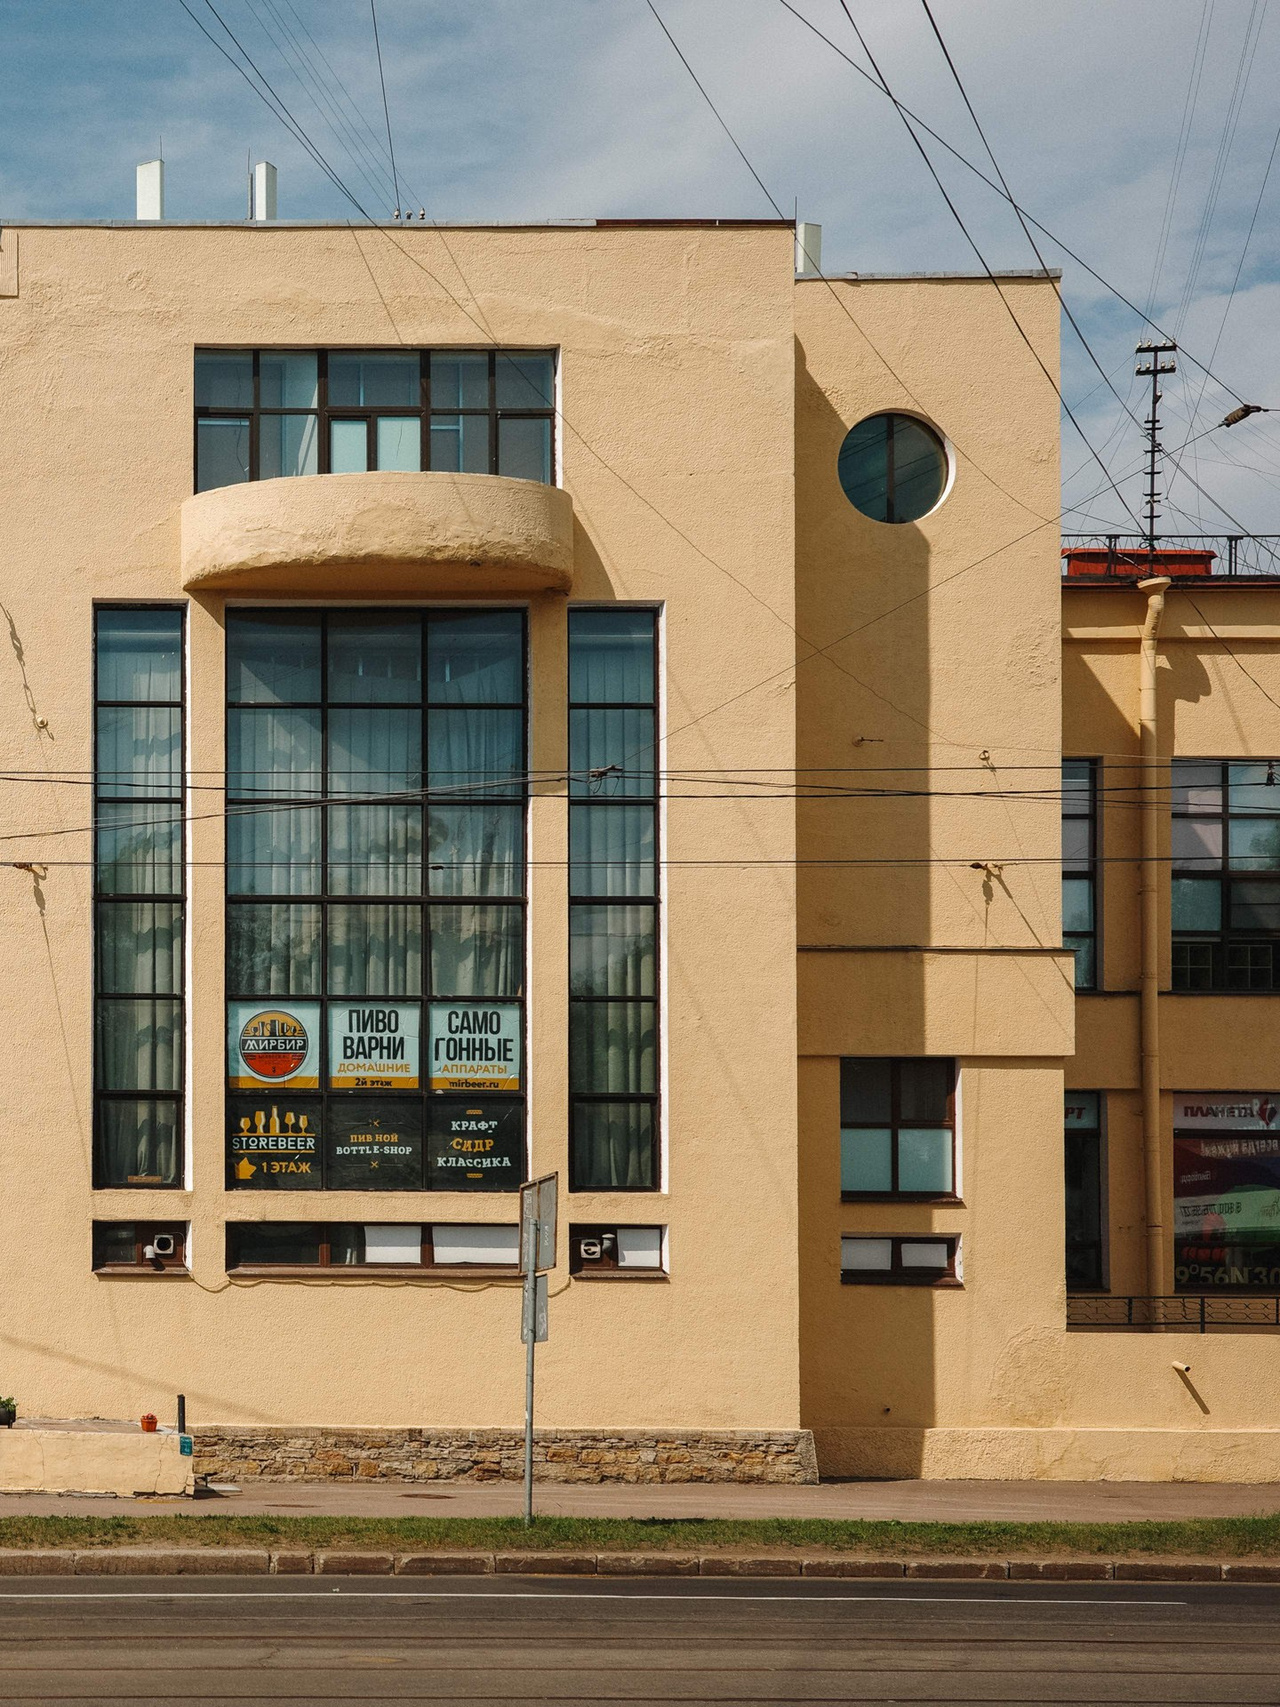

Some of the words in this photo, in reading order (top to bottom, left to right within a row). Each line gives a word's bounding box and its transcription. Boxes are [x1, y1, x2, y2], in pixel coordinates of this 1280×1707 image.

[348, 1009, 399, 1033] ПИВО
[447, 1010, 501, 1035] САМО
[343, 1036, 405, 1060] ВАРНИ
[434, 1037, 514, 1062] ГОННЫЕ
[337, 1063, 411, 1074] ДОМАШНИЕ
[441, 1064, 508, 1074] АППАРАТЫ
[355, 1077, 368, 1087] 2й
[370, 1079, 393, 1087] этаж
[449, 1079, 499, 1088] mirbeer.ru
[1183, 1105, 1255, 1118] ПЛАНЕТА
[450, 1120, 498, 1131] КРАФТ
[232, 1137, 316, 1150] STOREBEER
[336, 1146, 413, 1155] BOTTLE-SHOP
[261, 1161, 268, 1173] 1
[270, 1161, 312, 1173] ЭТАЖ
[436, 1156, 512, 1168] КЛАССИКА
